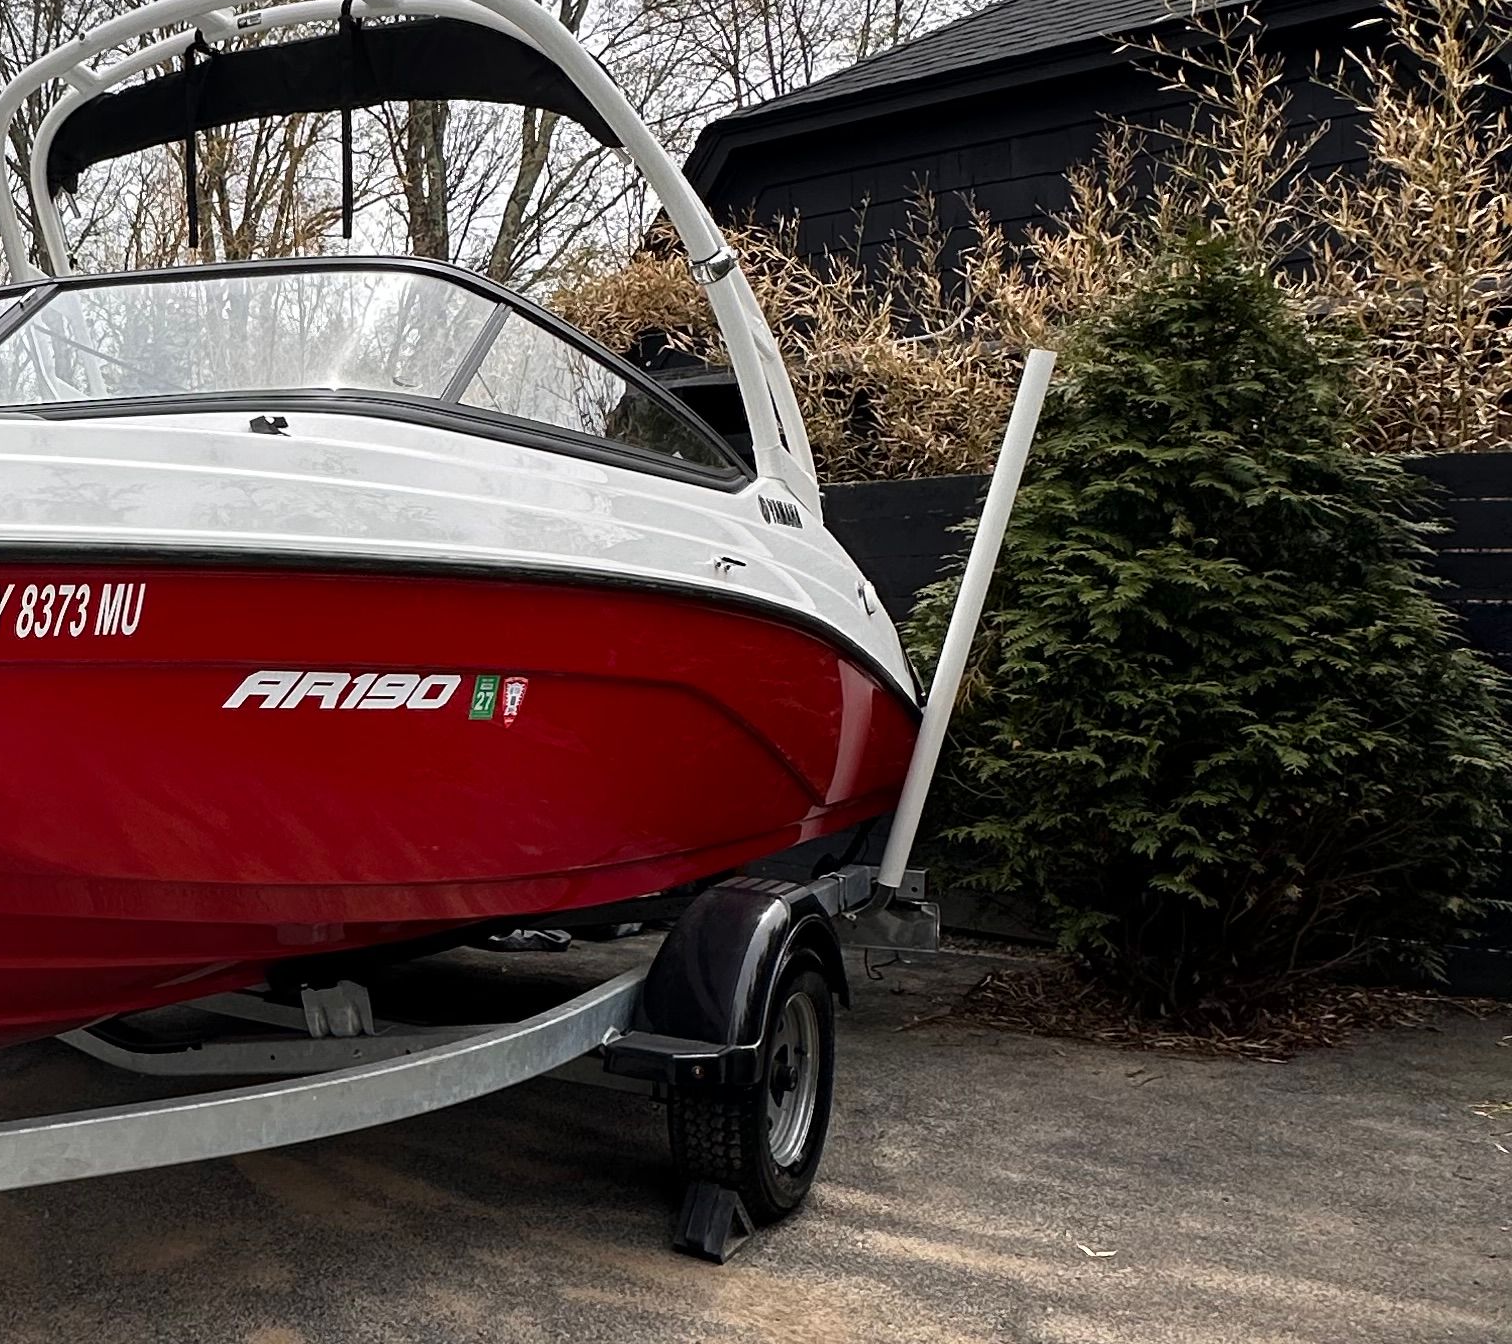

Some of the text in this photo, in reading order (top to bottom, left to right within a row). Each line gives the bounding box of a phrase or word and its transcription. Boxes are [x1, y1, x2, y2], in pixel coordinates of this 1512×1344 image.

[15, 583, 90, 639] 8373
[94, 583, 146, 636] MU
[221, 670, 462, 709] AR190
[473, 691, 494, 711] 27
